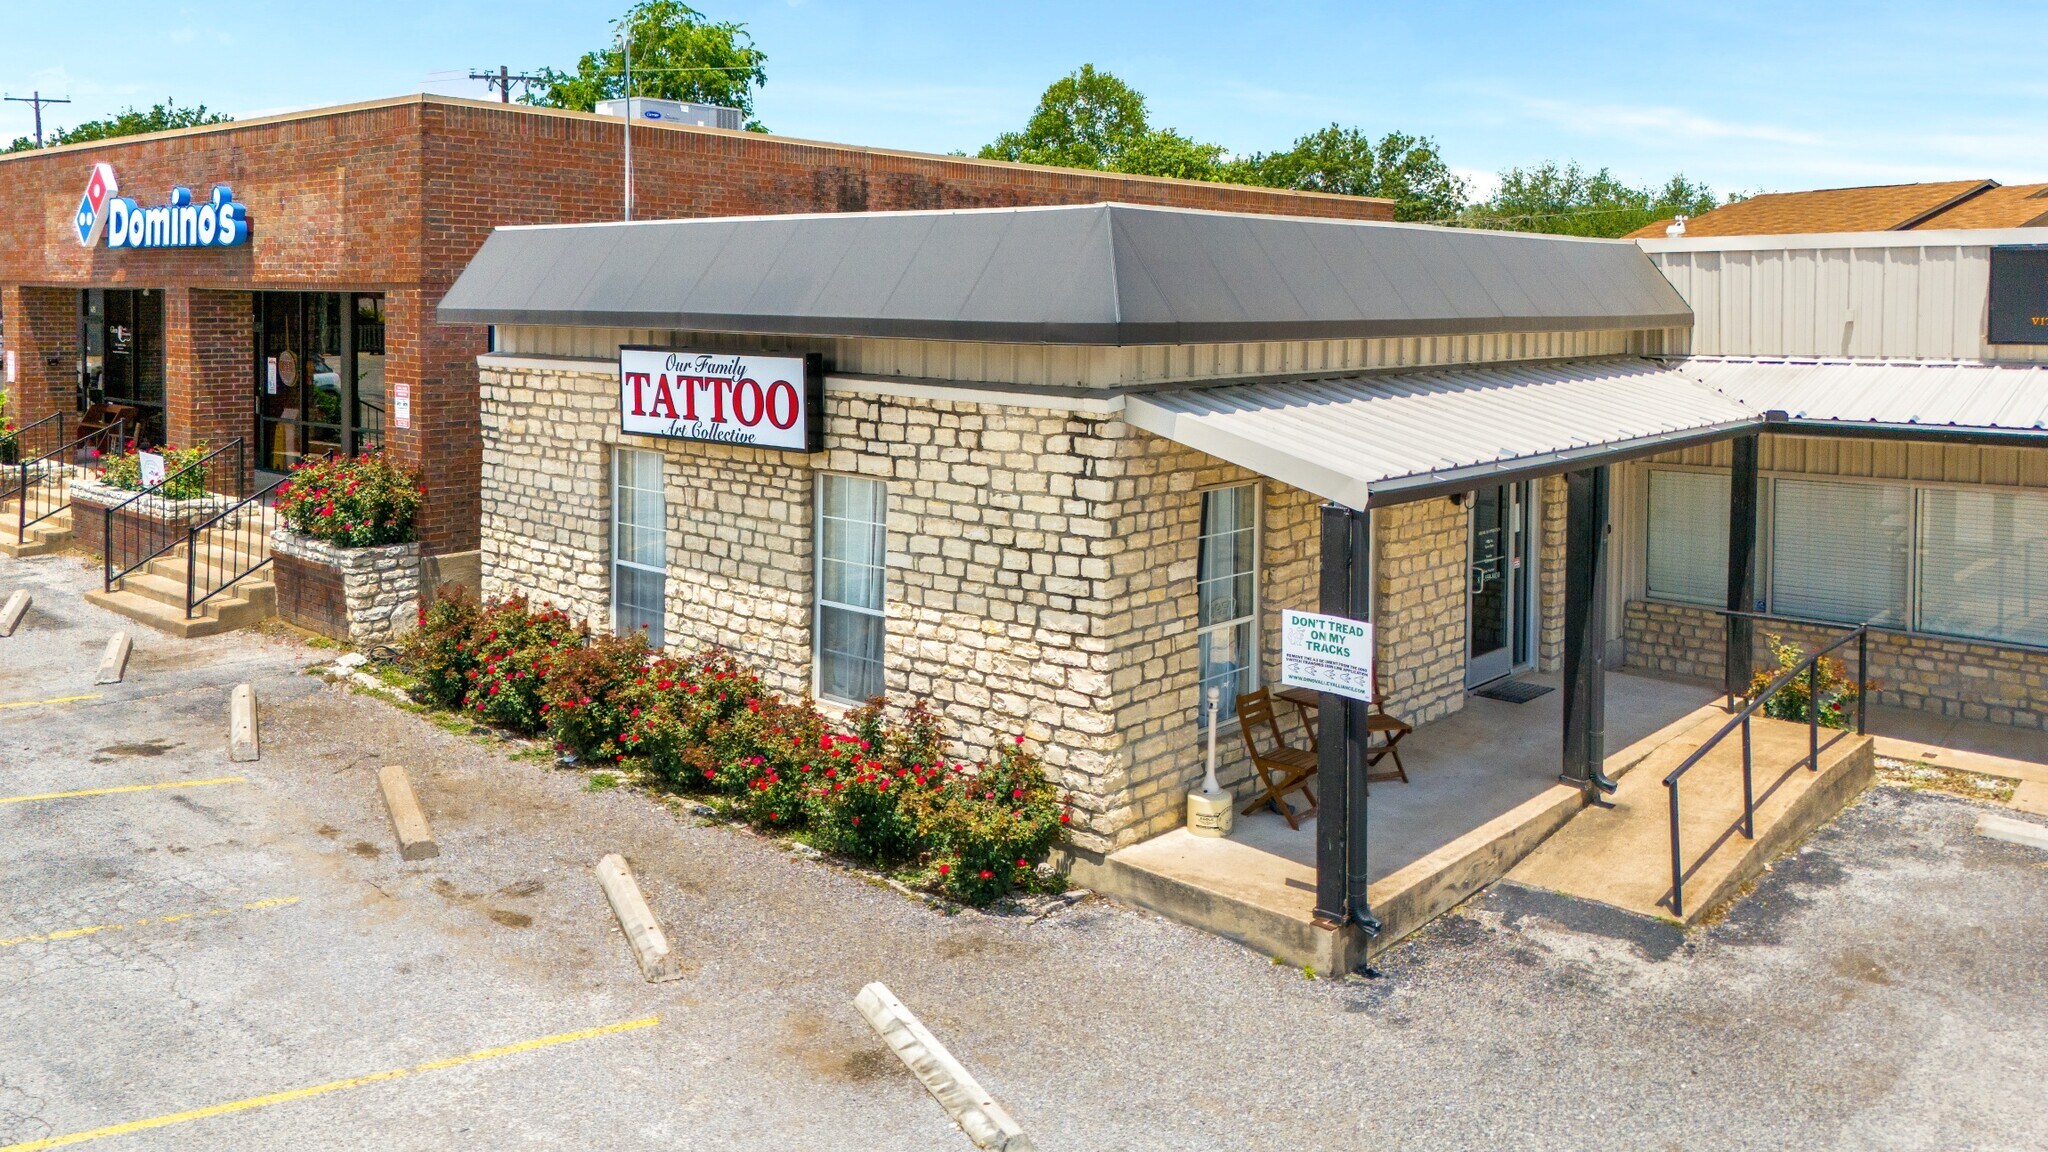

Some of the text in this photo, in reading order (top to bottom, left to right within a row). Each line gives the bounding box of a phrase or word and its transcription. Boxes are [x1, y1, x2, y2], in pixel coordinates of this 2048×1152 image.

[108, 186, 238, 248] Domino's
[665, 352, 748, 382] Our Family
[625, 371, 800, 431] TATTOO
[661, 419, 757, 444] Art Collective
[1291, 615, 1364, 637] DON'T TREAD
[1310, 630, 1346, 645] ON MY
[1305, 640, 1351, 658] TRACKS
